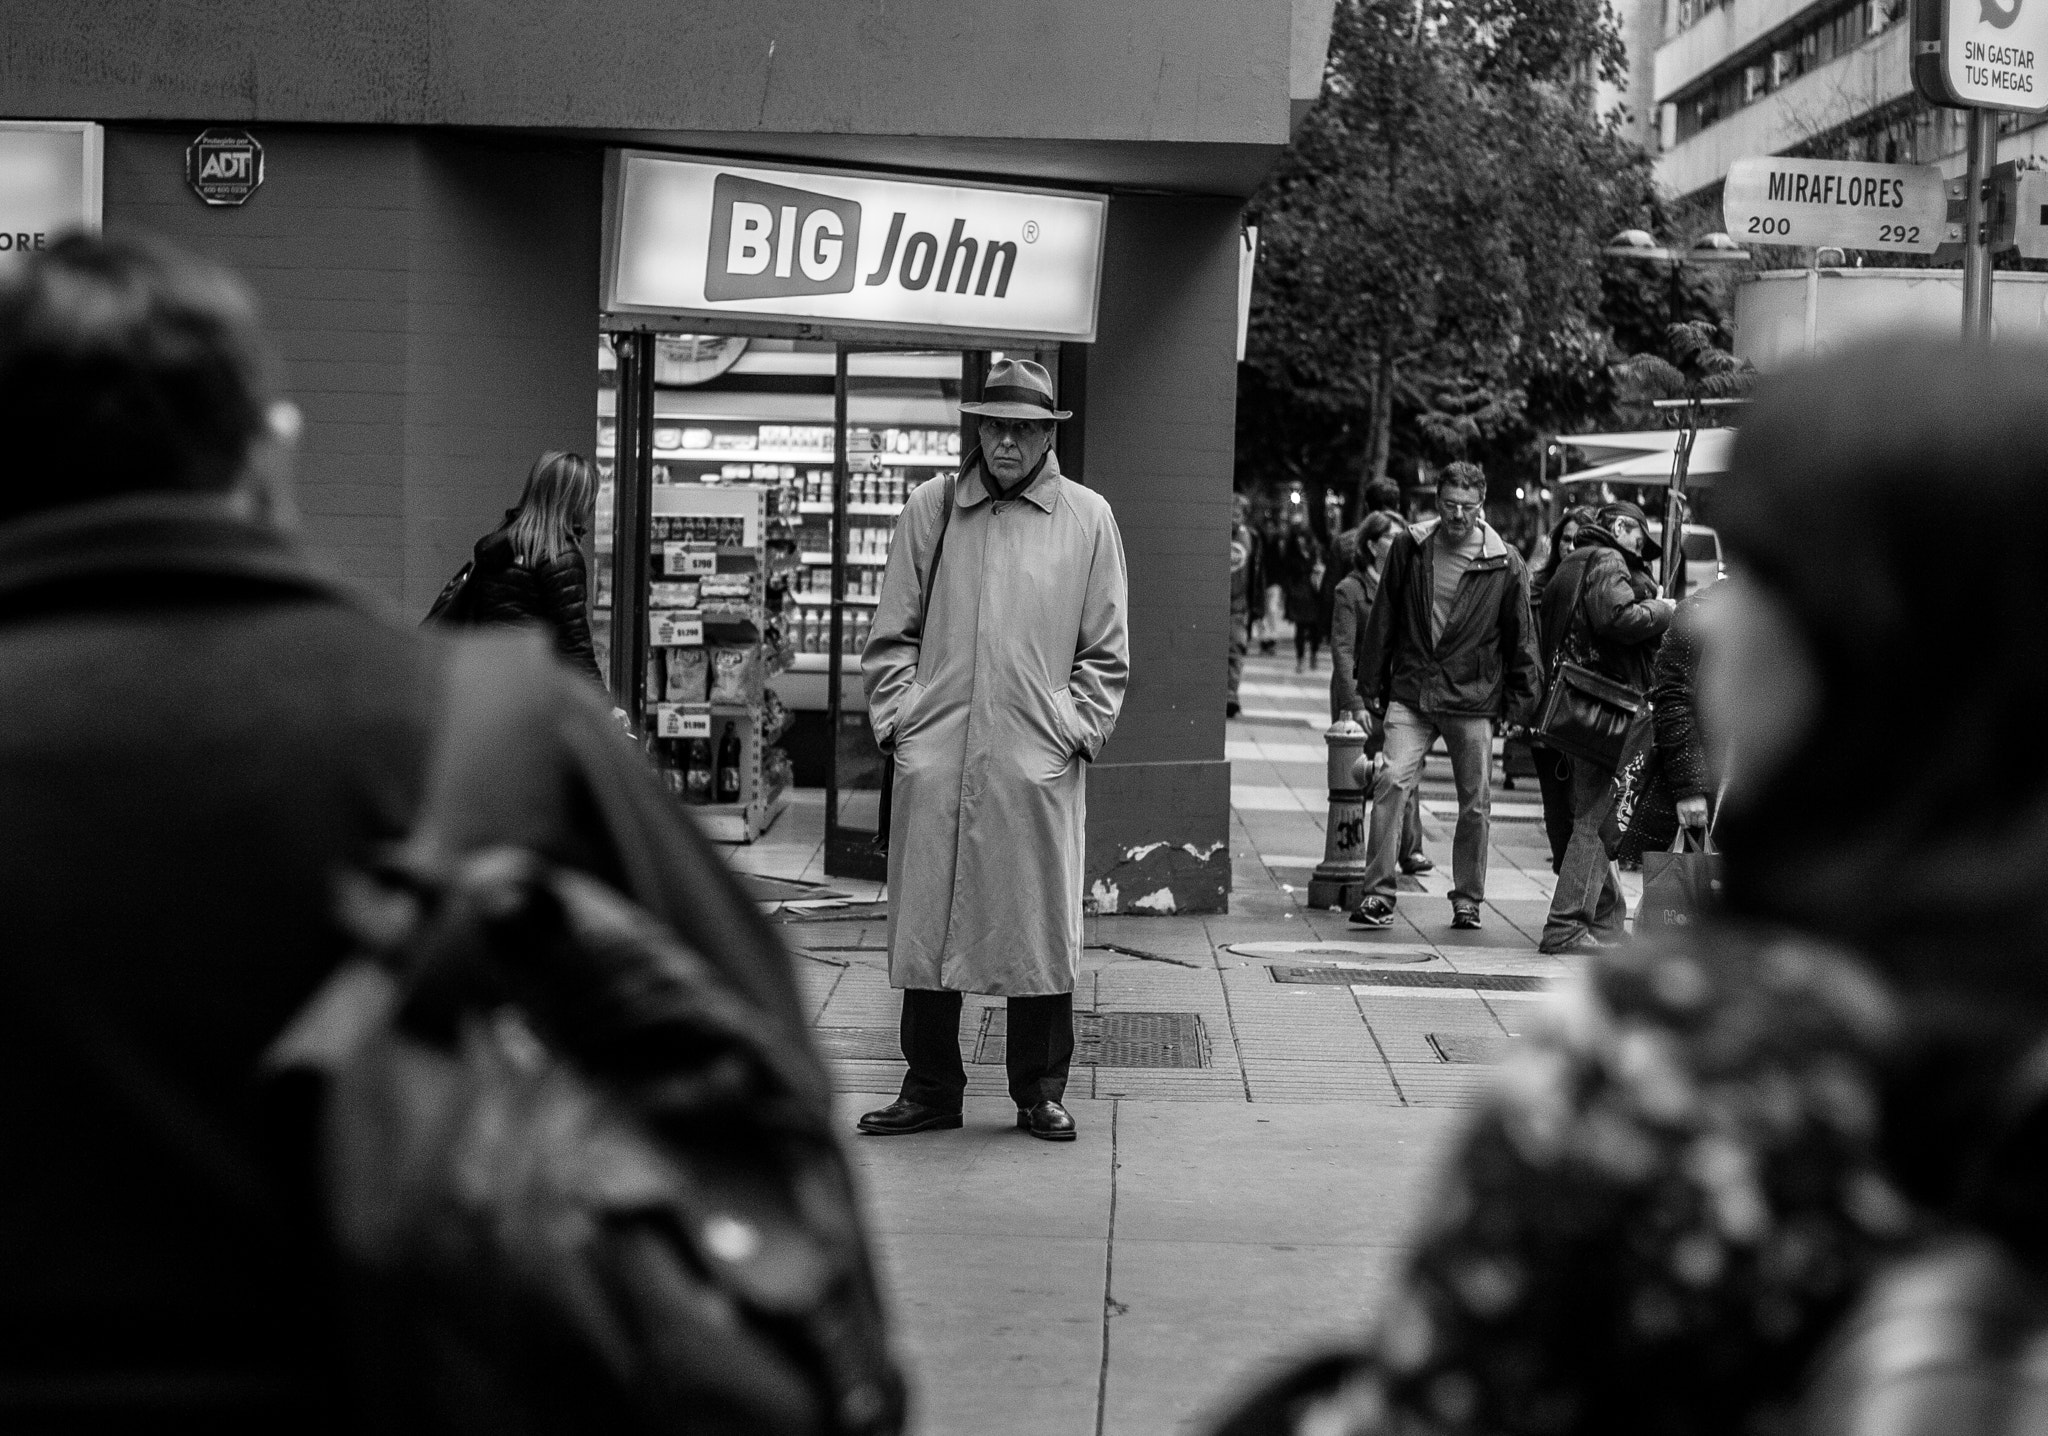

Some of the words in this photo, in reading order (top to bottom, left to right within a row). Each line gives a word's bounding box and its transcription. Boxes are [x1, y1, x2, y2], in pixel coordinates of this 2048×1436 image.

[1965, 41, 1985, 61] SIN
[1988, 45, 2035, 69] GASTAR
[1965, 65, 1988, 86] TUS
[1992, 69, 2033, 93] MEGAS
[201, 152, 251, 178] ADT
[1768, 171, 1904, 208] MIRAFLORES
[1748, 216, 1791, 235] 200
[1879, 225, 1920, 244] 292
[726, 201, 844, 282] BIG
[865, 212, 1018, 298] John
